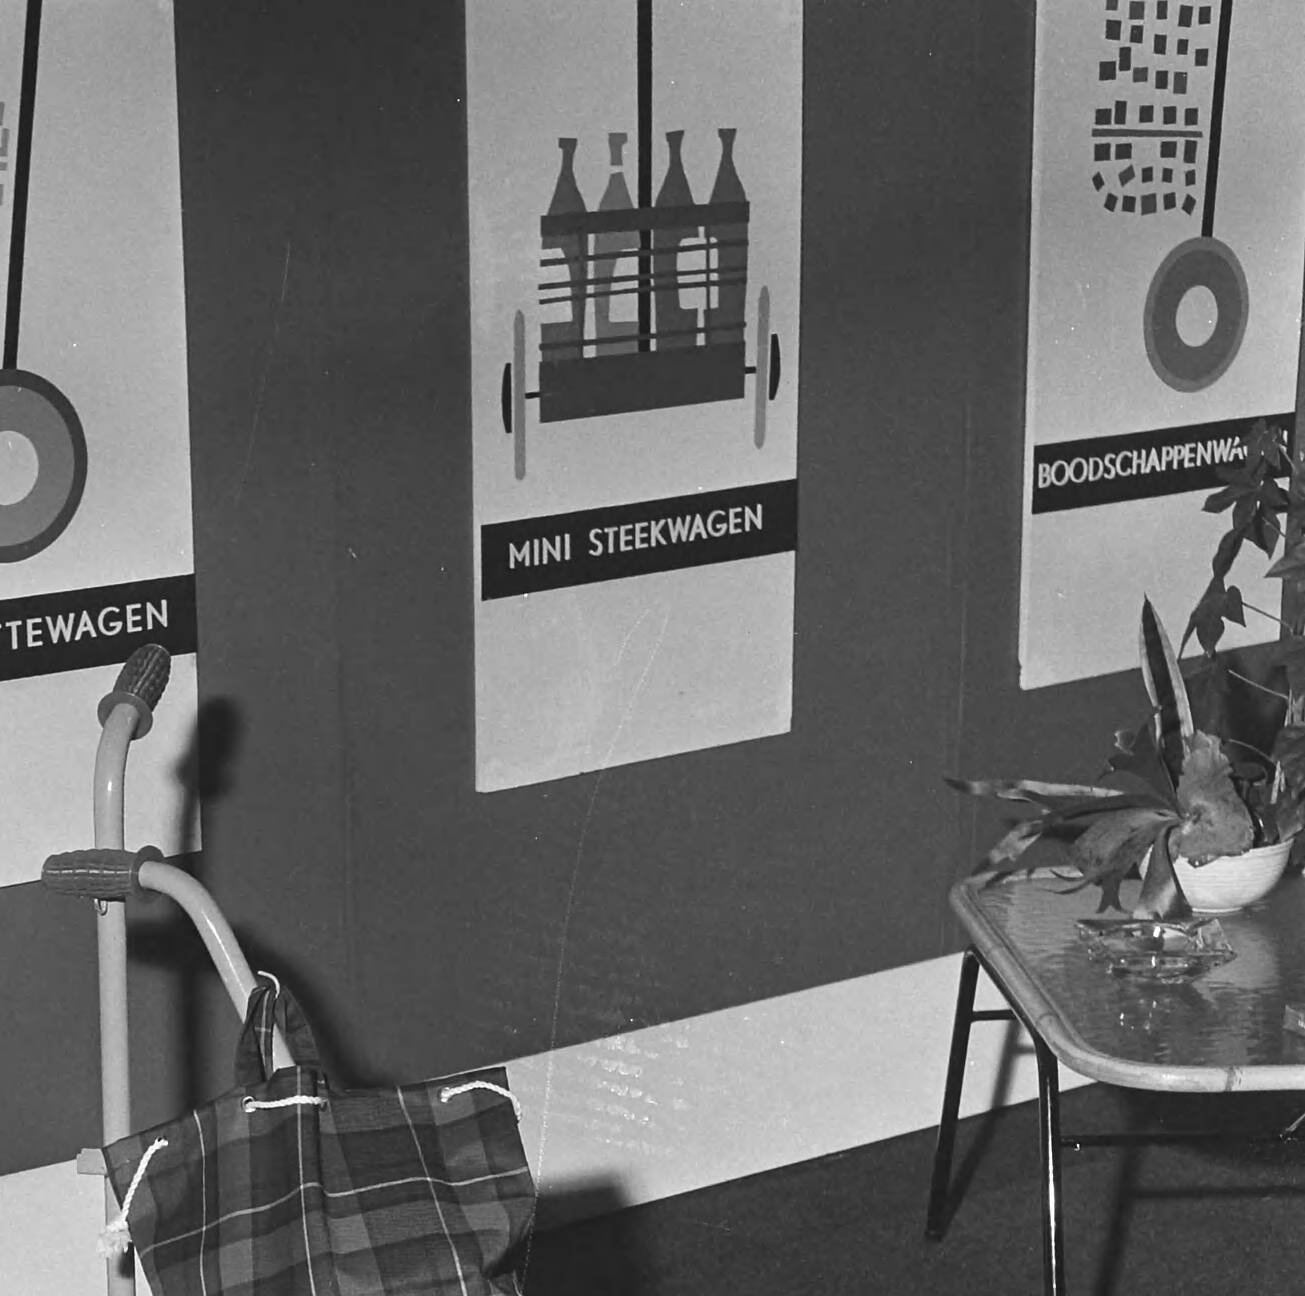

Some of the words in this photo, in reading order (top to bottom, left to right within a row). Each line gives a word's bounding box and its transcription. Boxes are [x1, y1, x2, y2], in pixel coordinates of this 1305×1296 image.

[1038, 429, 1288, 488] BOODSCHAPPENWA
[508, 533, 571, 569] MINI
[588, 503, 763, 557] STEEKWAGEN
